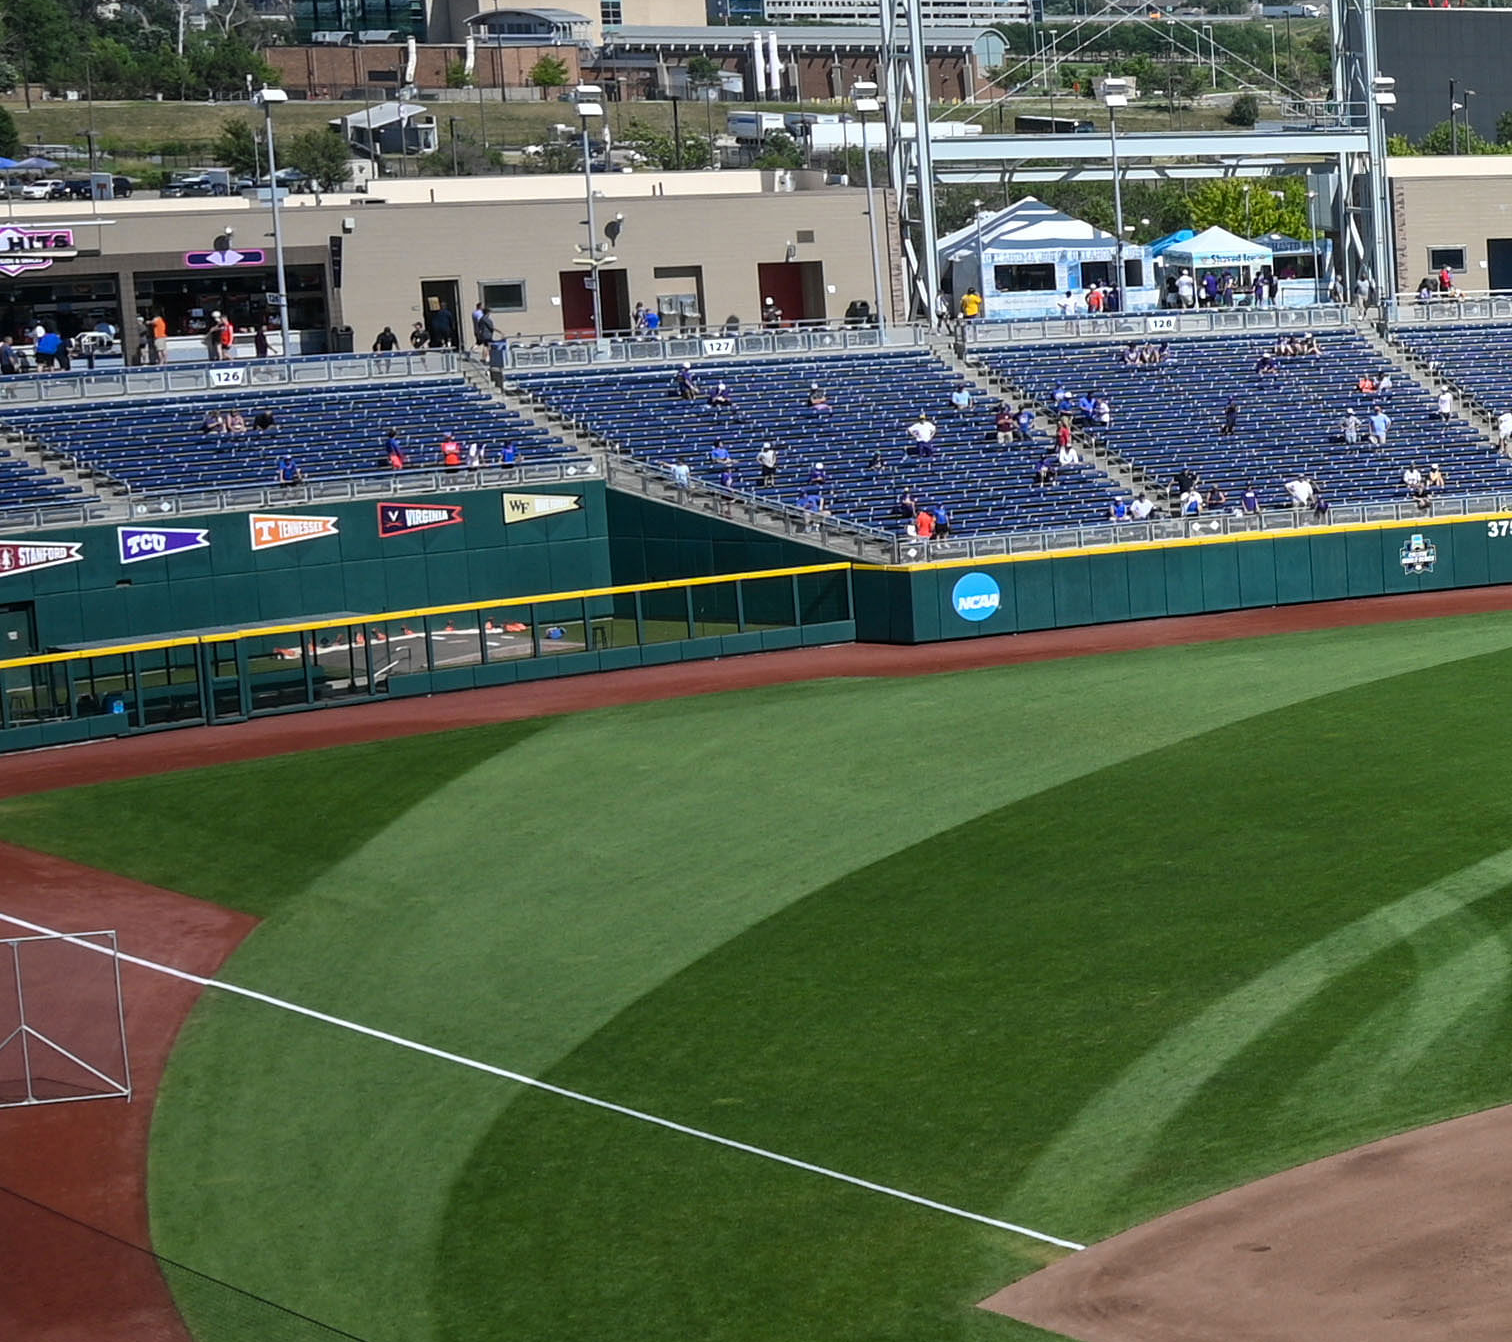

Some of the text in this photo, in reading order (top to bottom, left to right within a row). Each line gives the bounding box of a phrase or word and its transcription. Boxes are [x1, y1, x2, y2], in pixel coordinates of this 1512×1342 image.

[1210, 253, 1241, 263] Shaved
[1153, 319, 1172, 328] 128
[709, 342, 730, 351] 127
[216, 372, 240, 382] 126
[405, 509, 449, 527] VIRGINIA
[276, 520, 323, 538] TENNESSEE
[127, 533, 166, 555] TCU
[18, 547, 68, 566] STANFORD
[958, 593, 999, 611] NCAA
